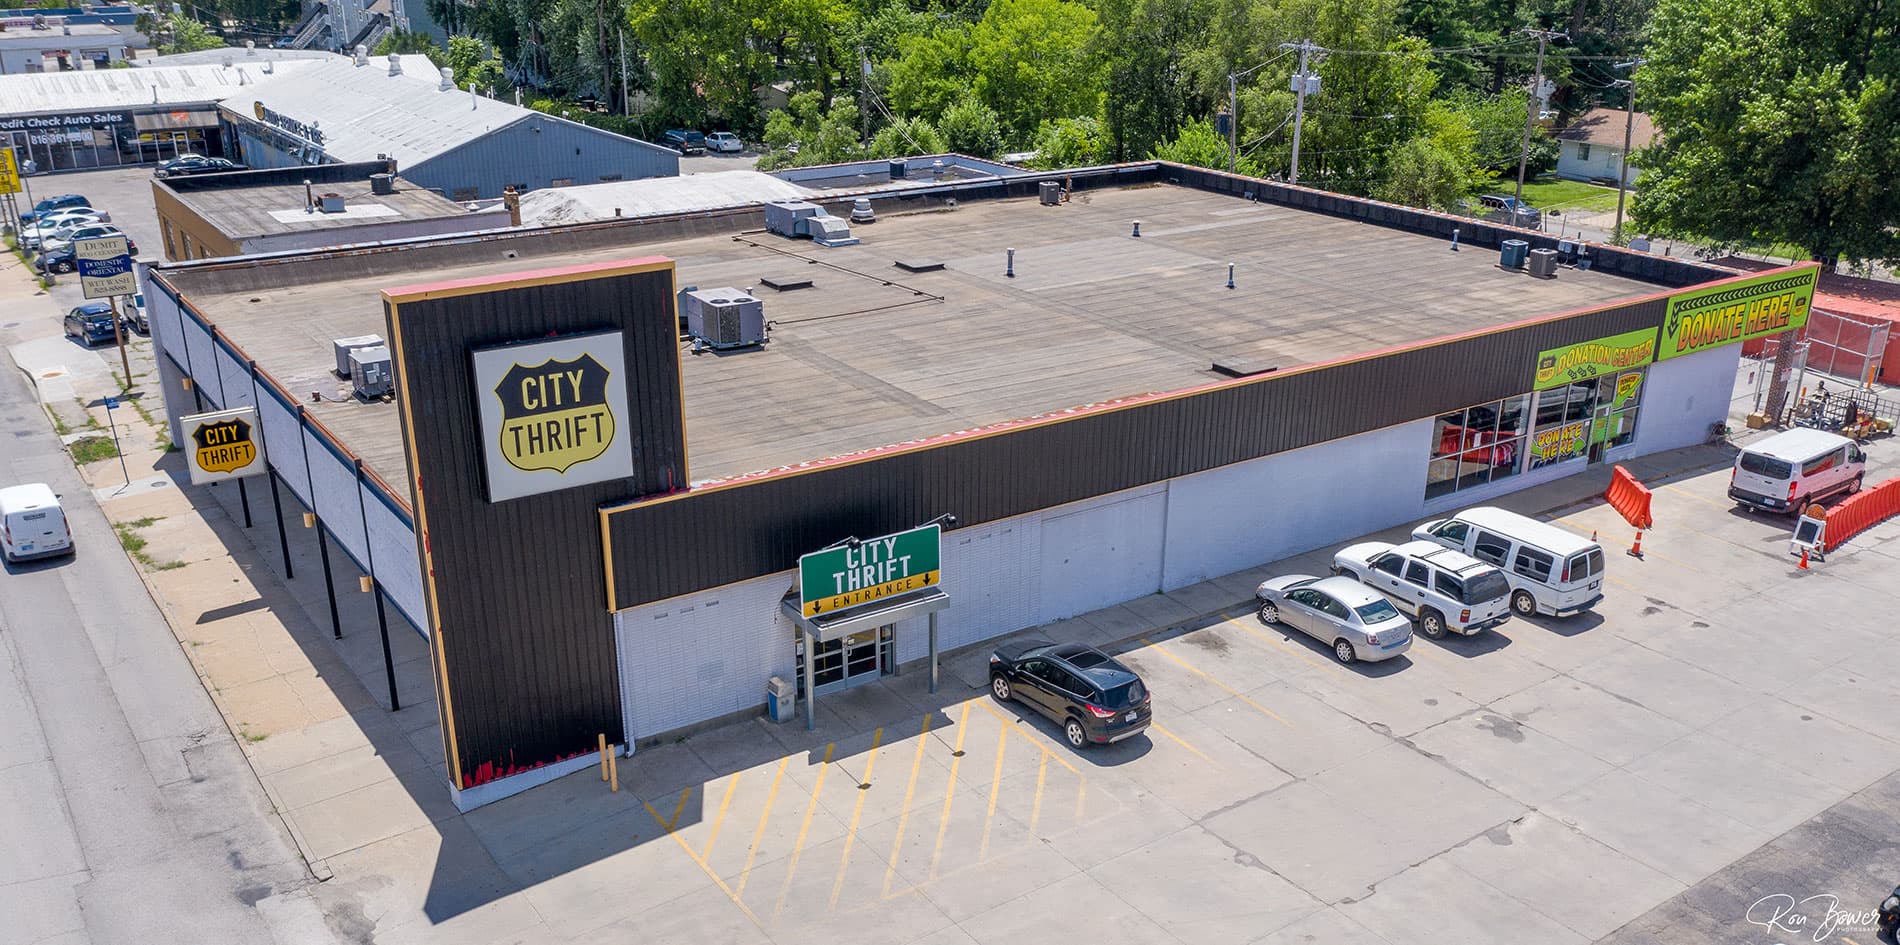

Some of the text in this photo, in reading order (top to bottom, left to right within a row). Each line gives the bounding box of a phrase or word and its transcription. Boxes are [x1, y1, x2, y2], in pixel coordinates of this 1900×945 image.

[0, 113, 123, 129] edit Check Auto Sales
[85, 258, 124, 268] DOMESTIC
[87, 266, 124, 275] ORIENTAL
[106, 277, 130, 285] WASH
[1677, 291, 1796, 352] DONATE HERE!
[1556, 338, 1653, 376] DONATION CENTER
[521, 369, 584, 410] CITY
[205, 425, 238, 445] CITY
[509, 412, 605, 458] THRIFT
[1537, 422, 1583, 447] DONATE
[201, 444, 250, 466] THRIFT
[1542, 437, 1574, 460] HERE
[846, 536, 897, 569] CITY
[832, 554, 912, 594] THRIFT
[833, 578, 912, 608] ENTRANCE
